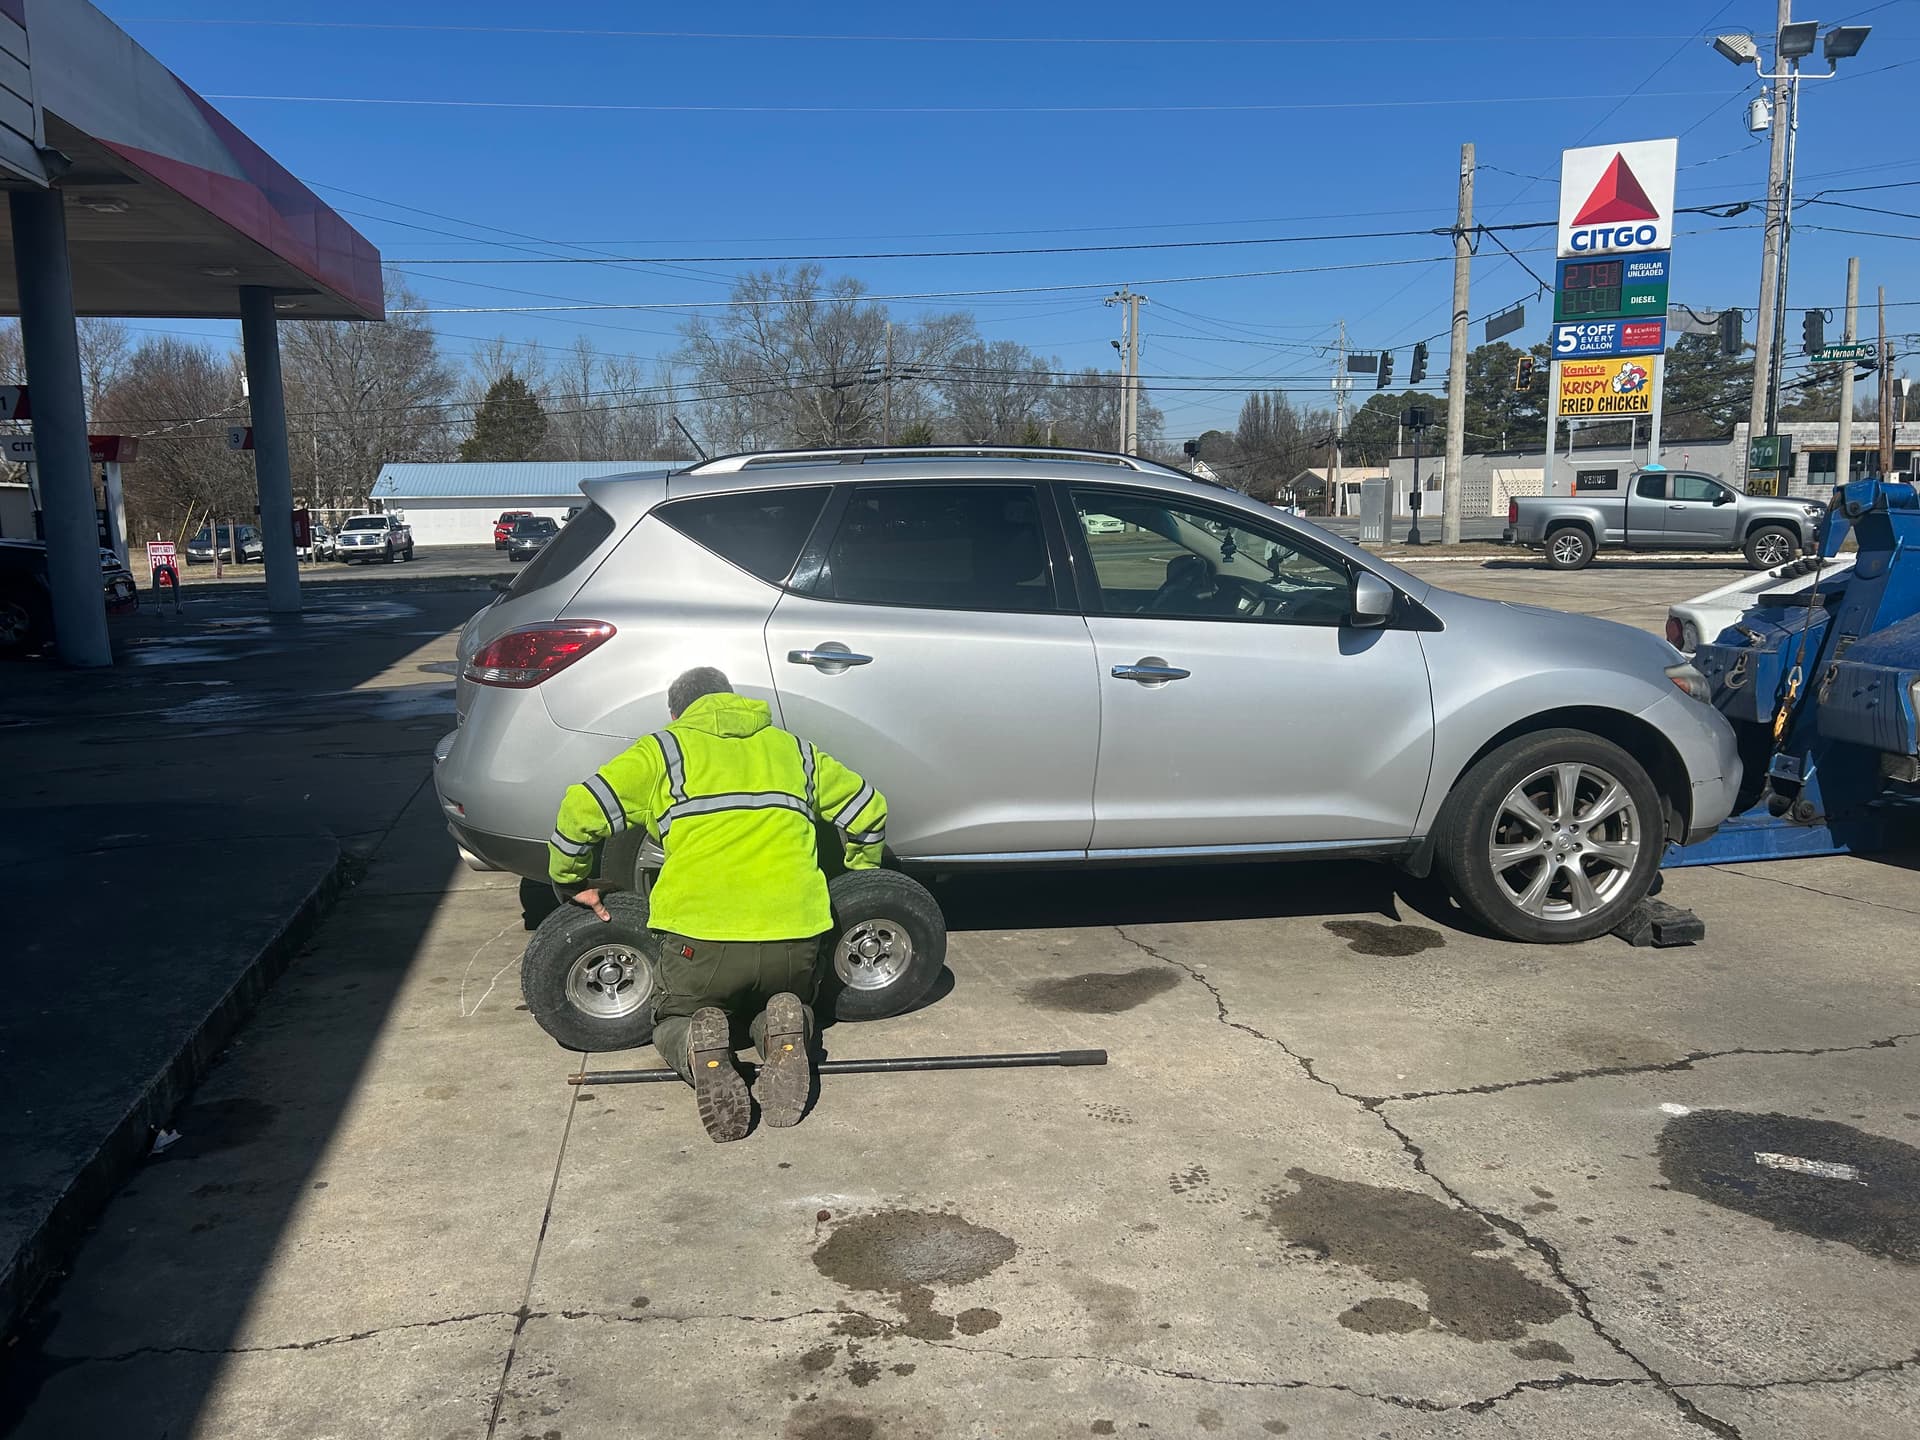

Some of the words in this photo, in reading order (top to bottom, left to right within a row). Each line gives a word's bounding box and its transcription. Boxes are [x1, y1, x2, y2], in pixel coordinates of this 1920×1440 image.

[1571, 225, 1657, 251] CITGO
[1630, 262, 1662, 271] REGULAR
[1628, 269, 1664, 277] UNLEADED
[1631, 296, 1656, 304] DIESEL
[1587, 324, 1616, 336] OFF
[1581, 335, 1613, 343] EVERY
[1580, 342, 1612, 351] GALLON
[1833, 349, 1855, 358] Vernon
[1856, 347, 1865, 357] Rd
[1563, 365, 1606, 377] Kanku's
[1562, 380, 1609, 395] KRISPY
[1561, 397, 1594, 413] FRIED
[1598, 394, 1648, 411] CHICKEN
[233, 433, 240, 443] 3
[12, 442, 33, 452] CIT
